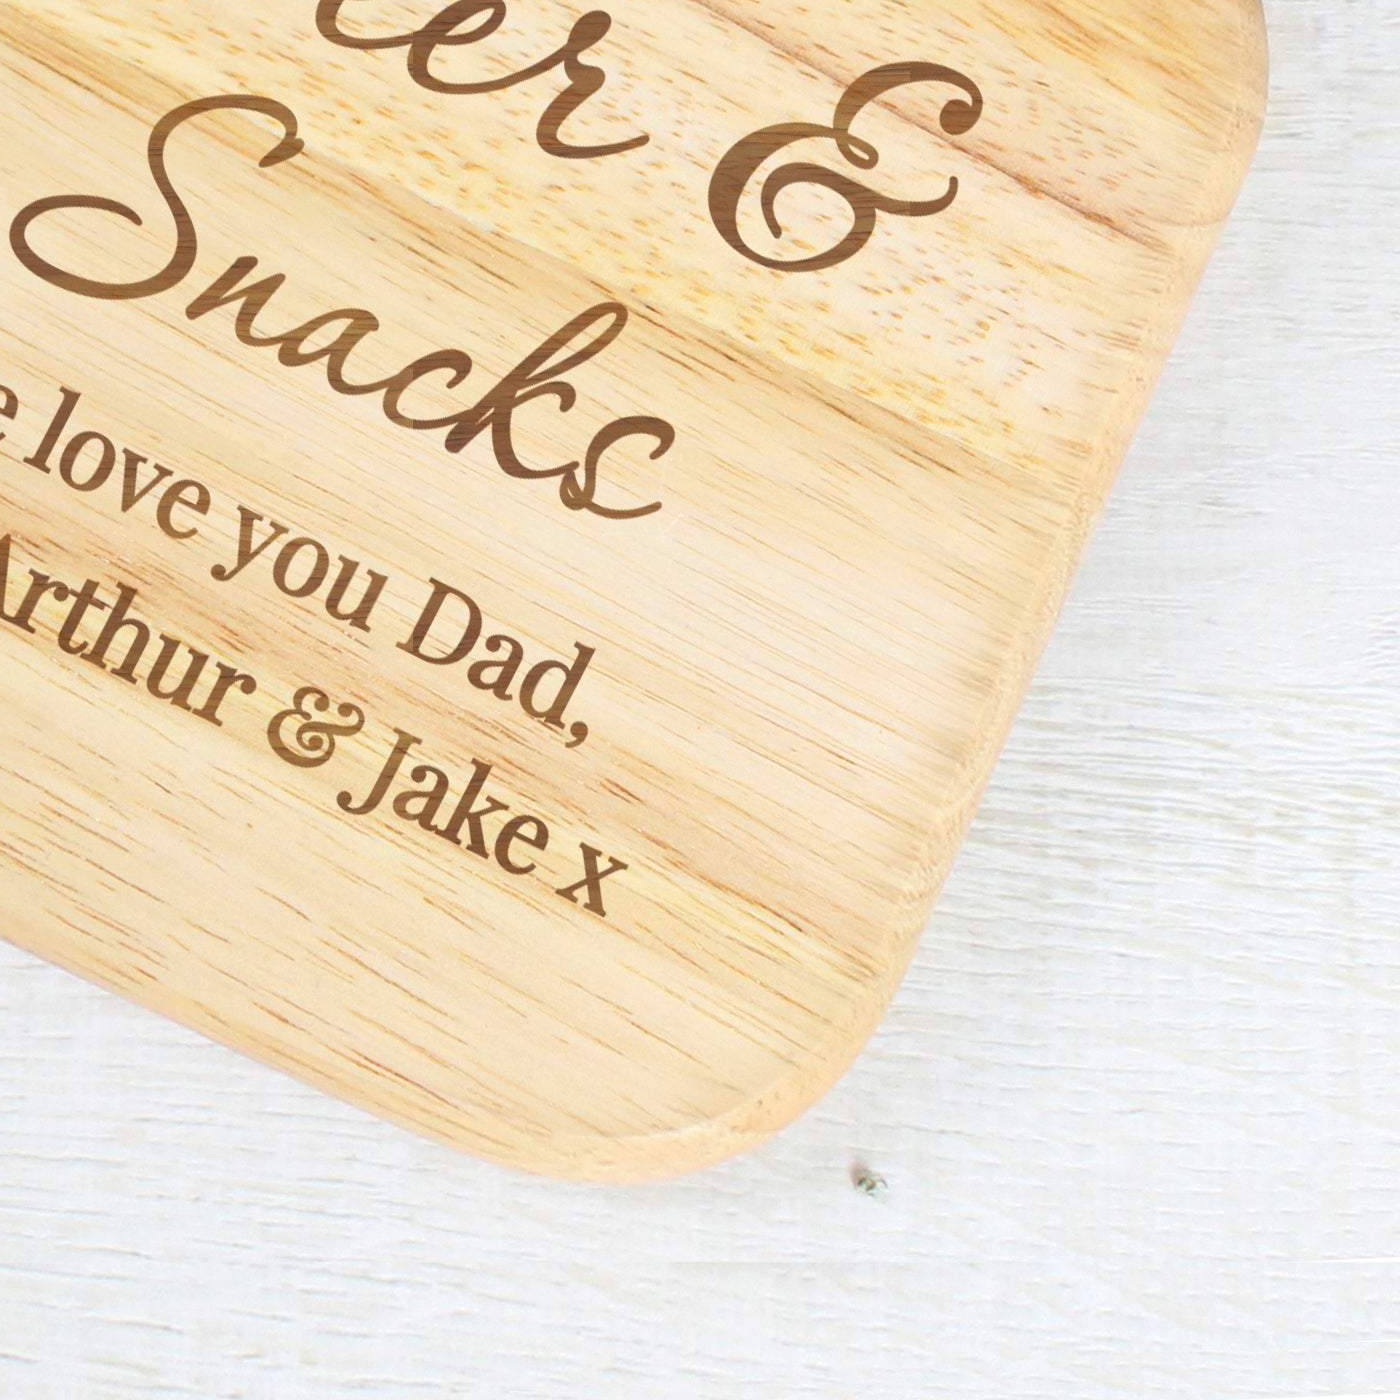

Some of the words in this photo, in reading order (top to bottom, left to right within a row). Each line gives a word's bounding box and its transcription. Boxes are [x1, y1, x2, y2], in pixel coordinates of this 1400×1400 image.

[10, 95, 674, 518] Snacks
[709, 62, 982, 272] &
[22, 385, 211, 538] love
[211, 505, 387, 633] you
[395, 576, 596, 748] Dad,
[267, 686, 365, 768] &
[336, 727, 550, 876] Jake
[555, 842, 629, 918] x
